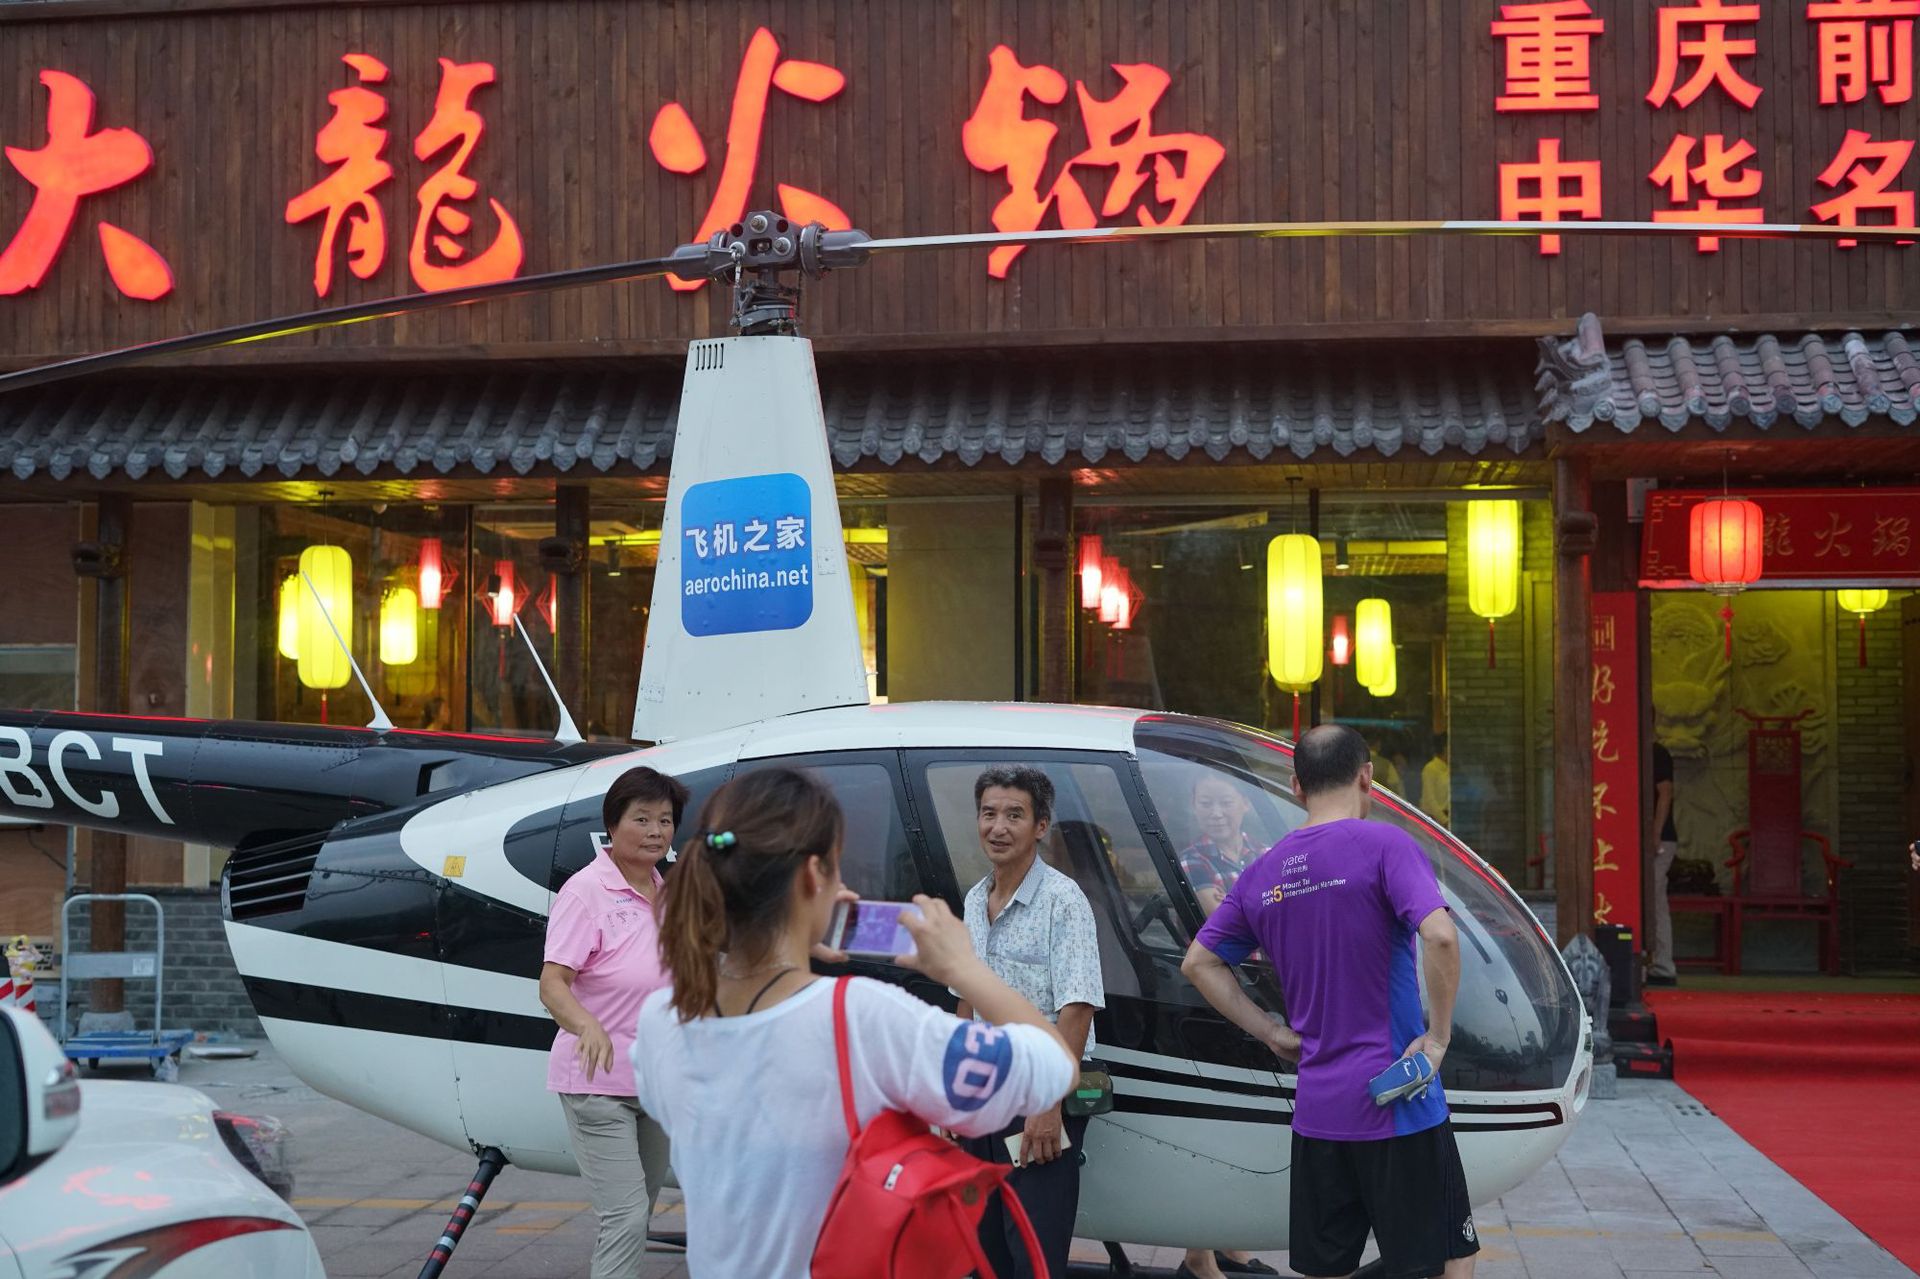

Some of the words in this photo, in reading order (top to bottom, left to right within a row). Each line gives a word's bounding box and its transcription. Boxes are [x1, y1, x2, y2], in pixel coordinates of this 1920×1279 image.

[1491, 0, 1920, 111] 重庆前
[1499, 129, 1917, 254] 中华名
[685, 516, 806, 559] 飞机之家
[685, 564, 809, 596] aerochina.net
[0, 725, 176, 825] BCT
[1273, 885, 1284, 903] 5
[1282, 880, 1302, 891] Mount
[1283, 884, 1320, 898] International
[1320, 878, 1346, 889] Marathon
